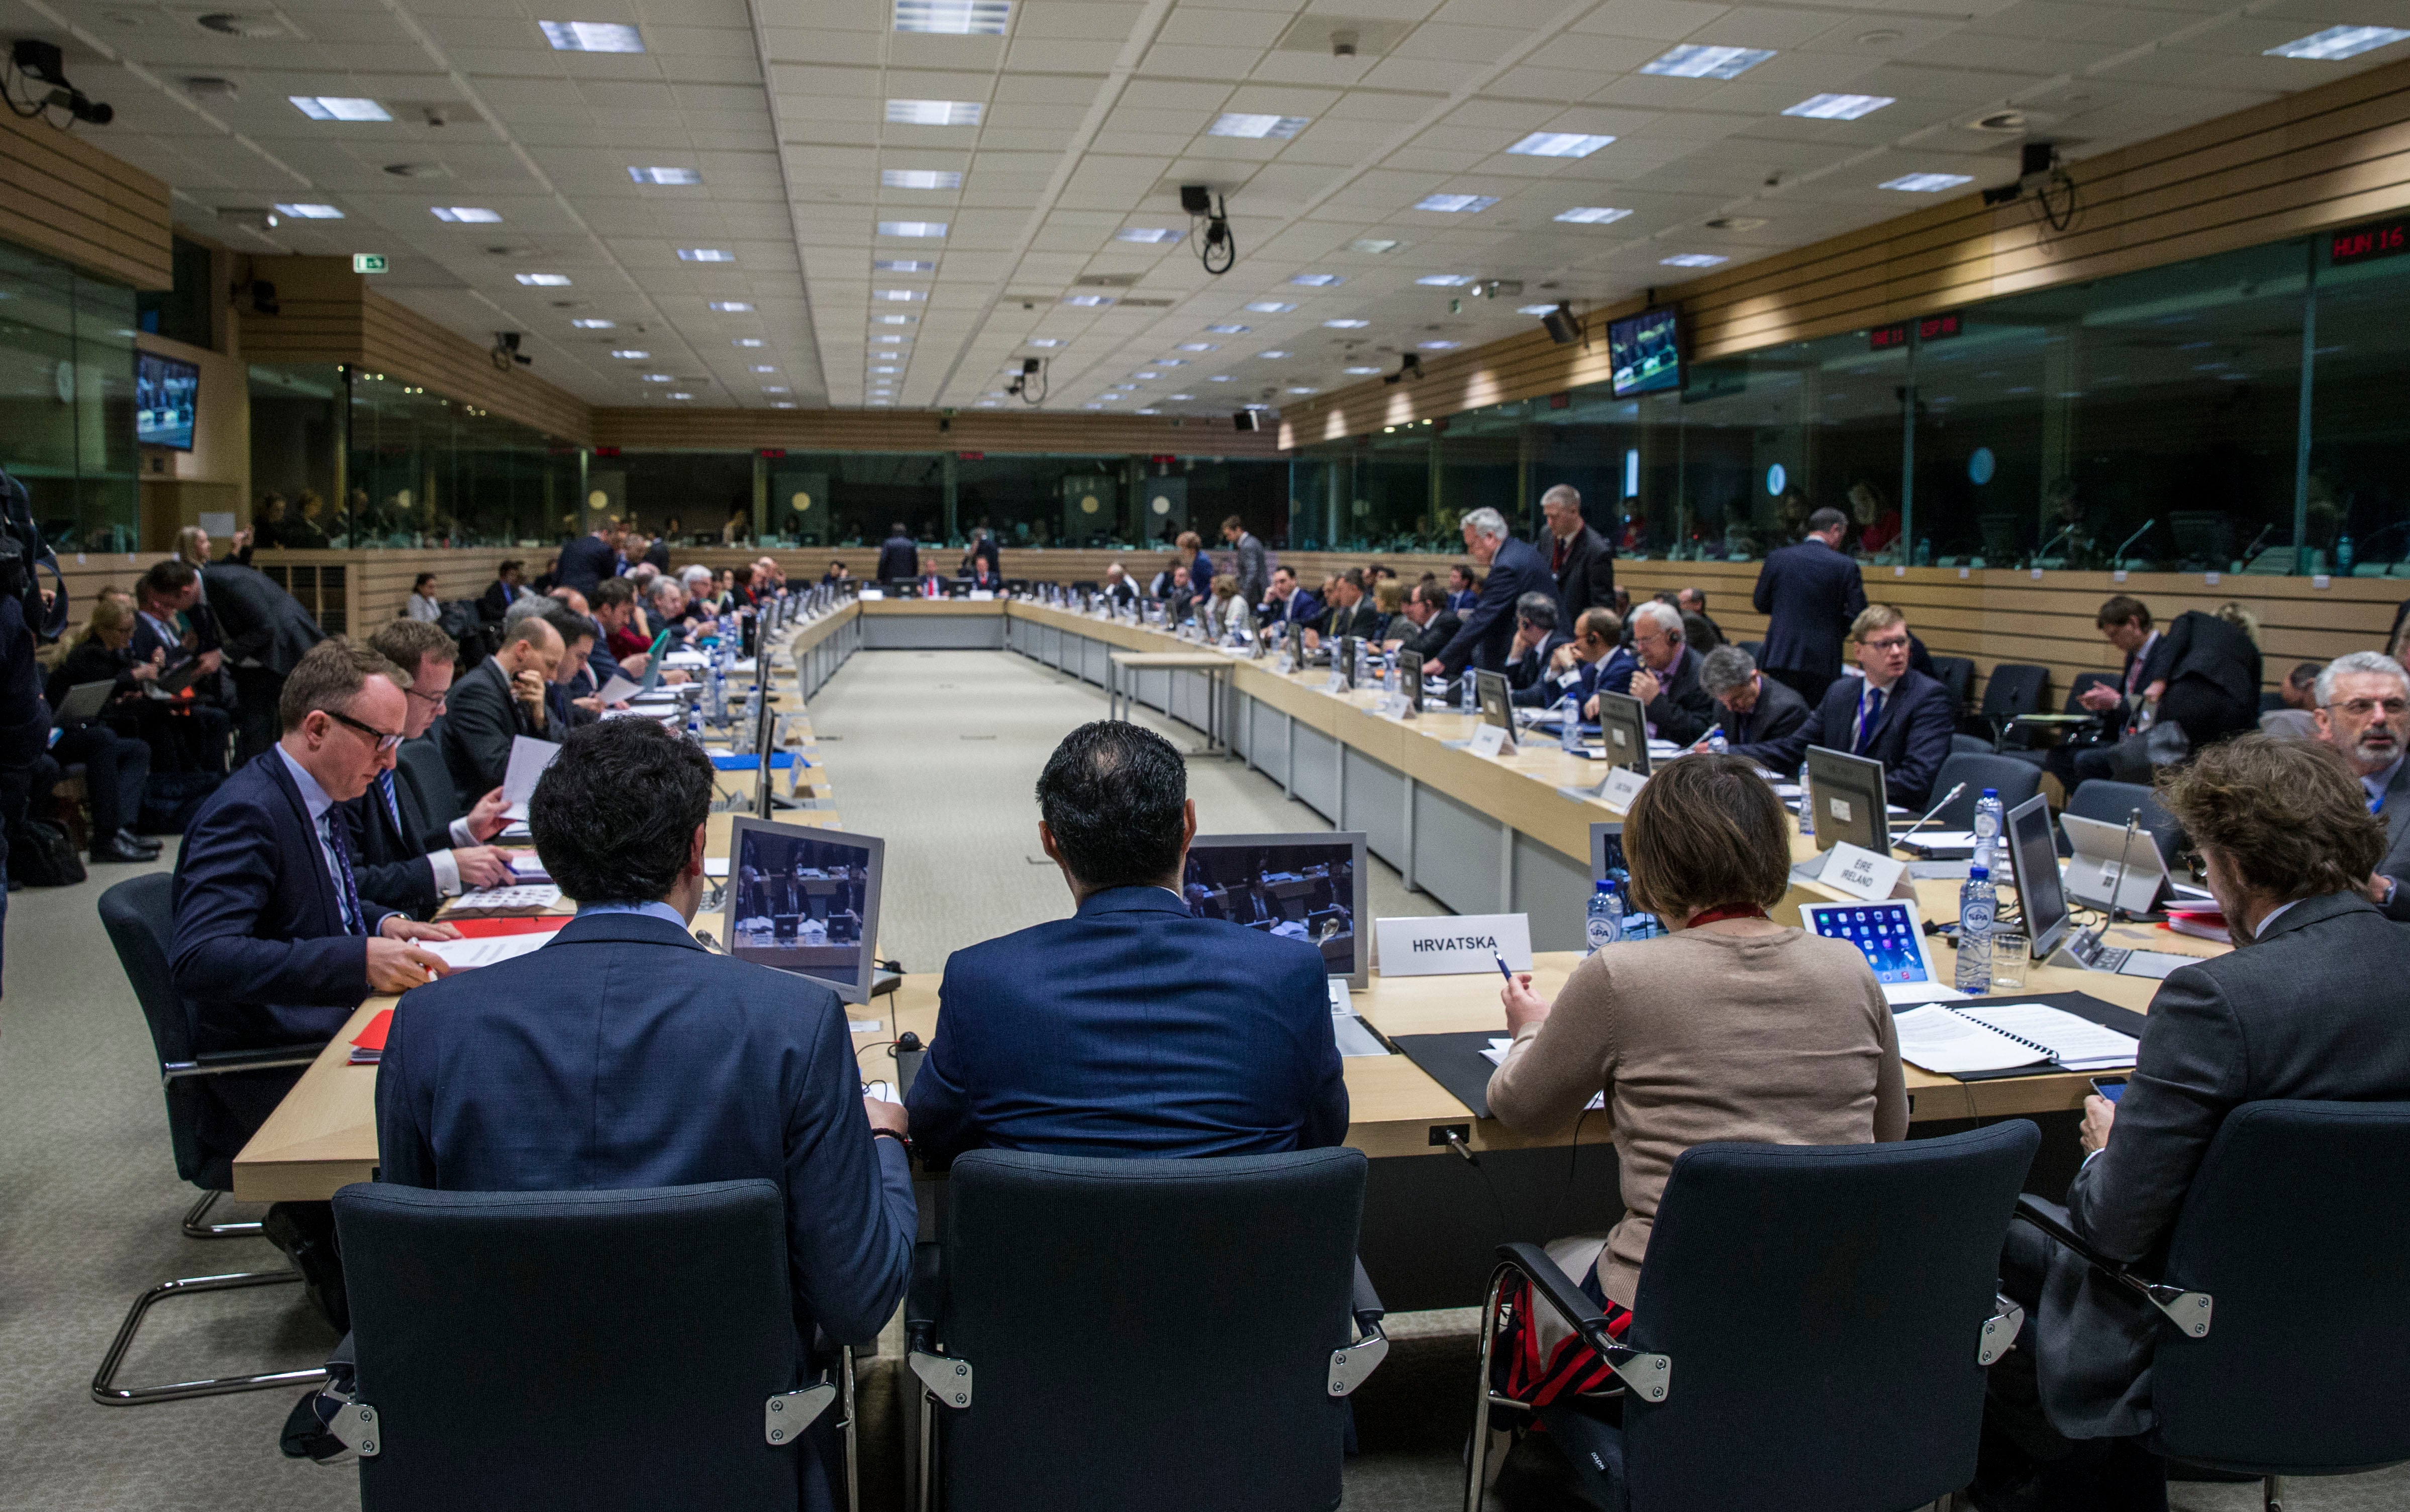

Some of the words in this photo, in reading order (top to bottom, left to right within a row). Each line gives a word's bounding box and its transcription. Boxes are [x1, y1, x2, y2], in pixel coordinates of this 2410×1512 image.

[2334, 233, 2373, 258] HUN
[2380, 226, 2404, 249] 16
[1841, 869, 1873, 887] IRELAND
[1590, 928, 1609, 937] SPA
[1413, 936, 1497, 952] HRVATSKA
